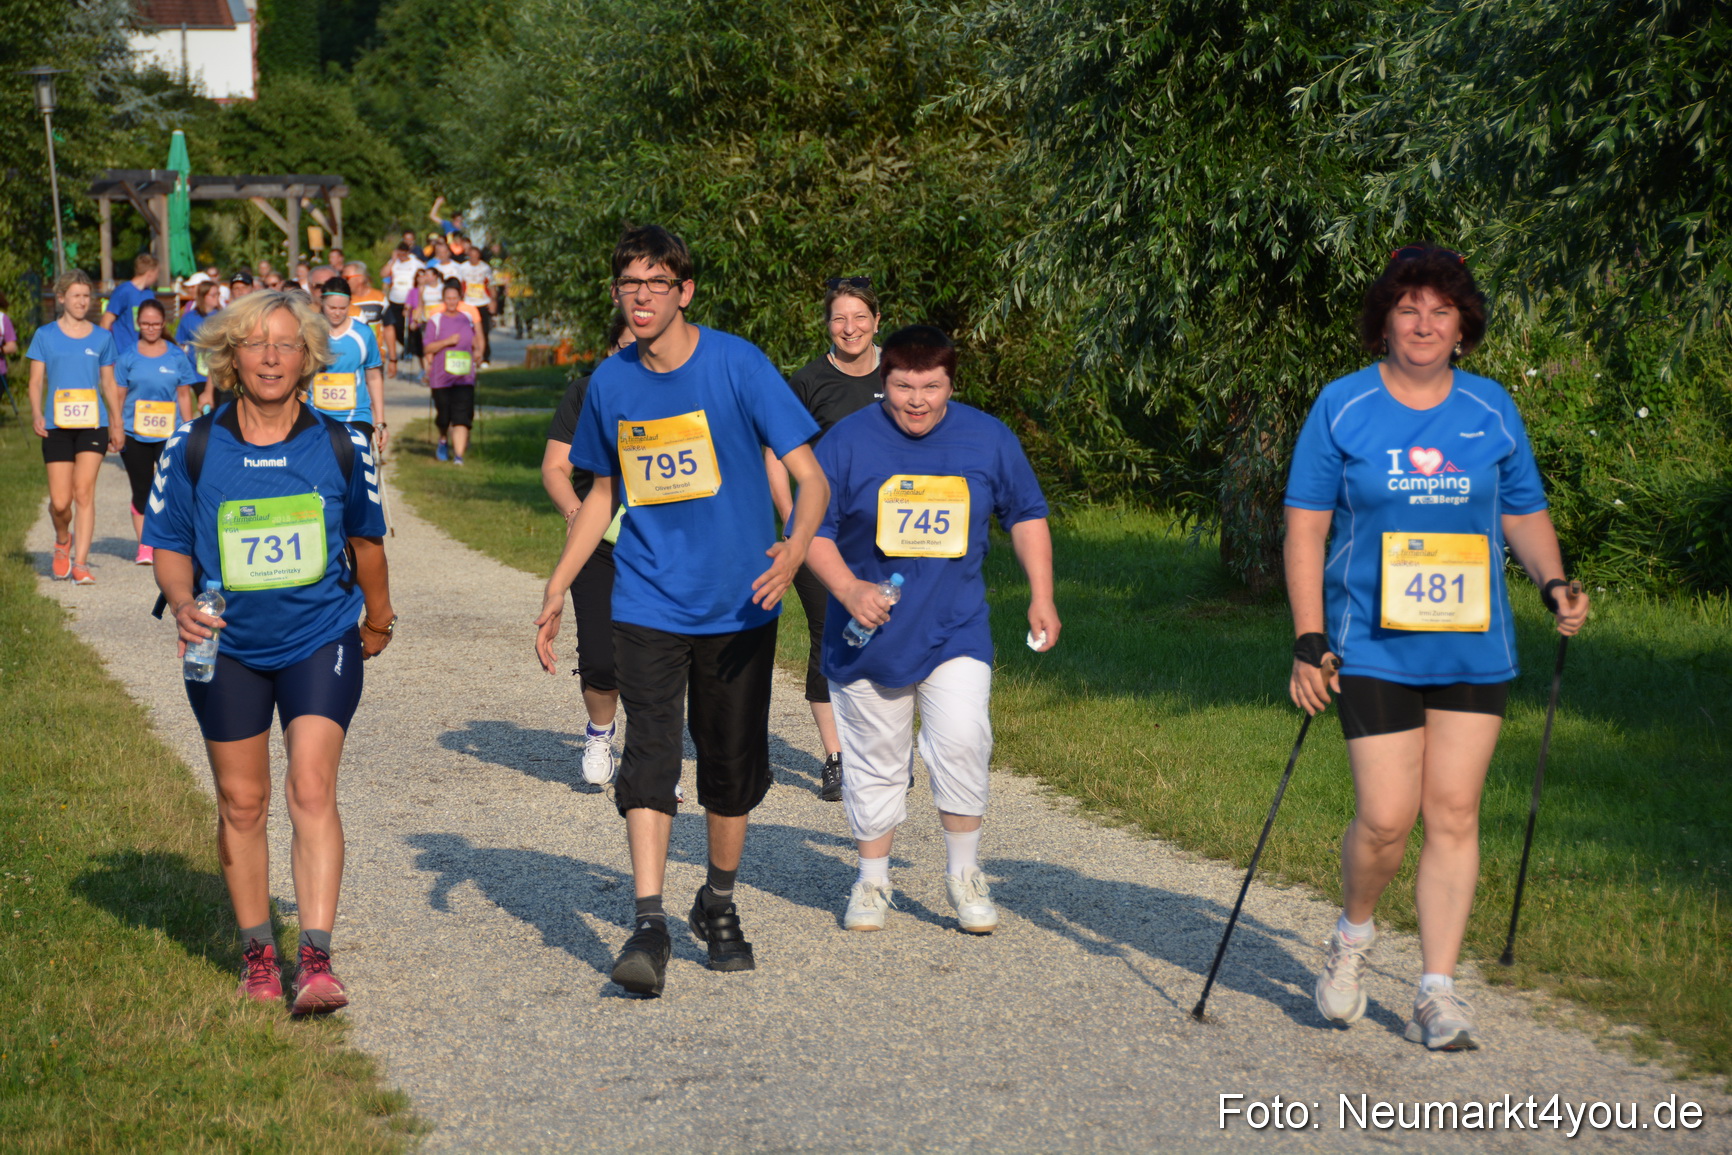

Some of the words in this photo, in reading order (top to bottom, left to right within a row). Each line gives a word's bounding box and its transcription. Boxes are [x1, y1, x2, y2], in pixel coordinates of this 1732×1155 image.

[322, 388, 347, 400] 562
[63, 404, 89, 417] 567
[142, 415, 167, 428] 566
[244, 456, 287, 467] hummel
[637, 449, 698, 481] 795
[1386, 449, 1404, 475] I
[1387, 474, 1471, 494] camping
[1438, 495, 1470, 505] Berger
[233, 513, 271, 523] firmenlauf
[897, 508, 950, 535] 745
[240, 532, 301, 565] 731
[1404, 573, 1465, 604] 481
